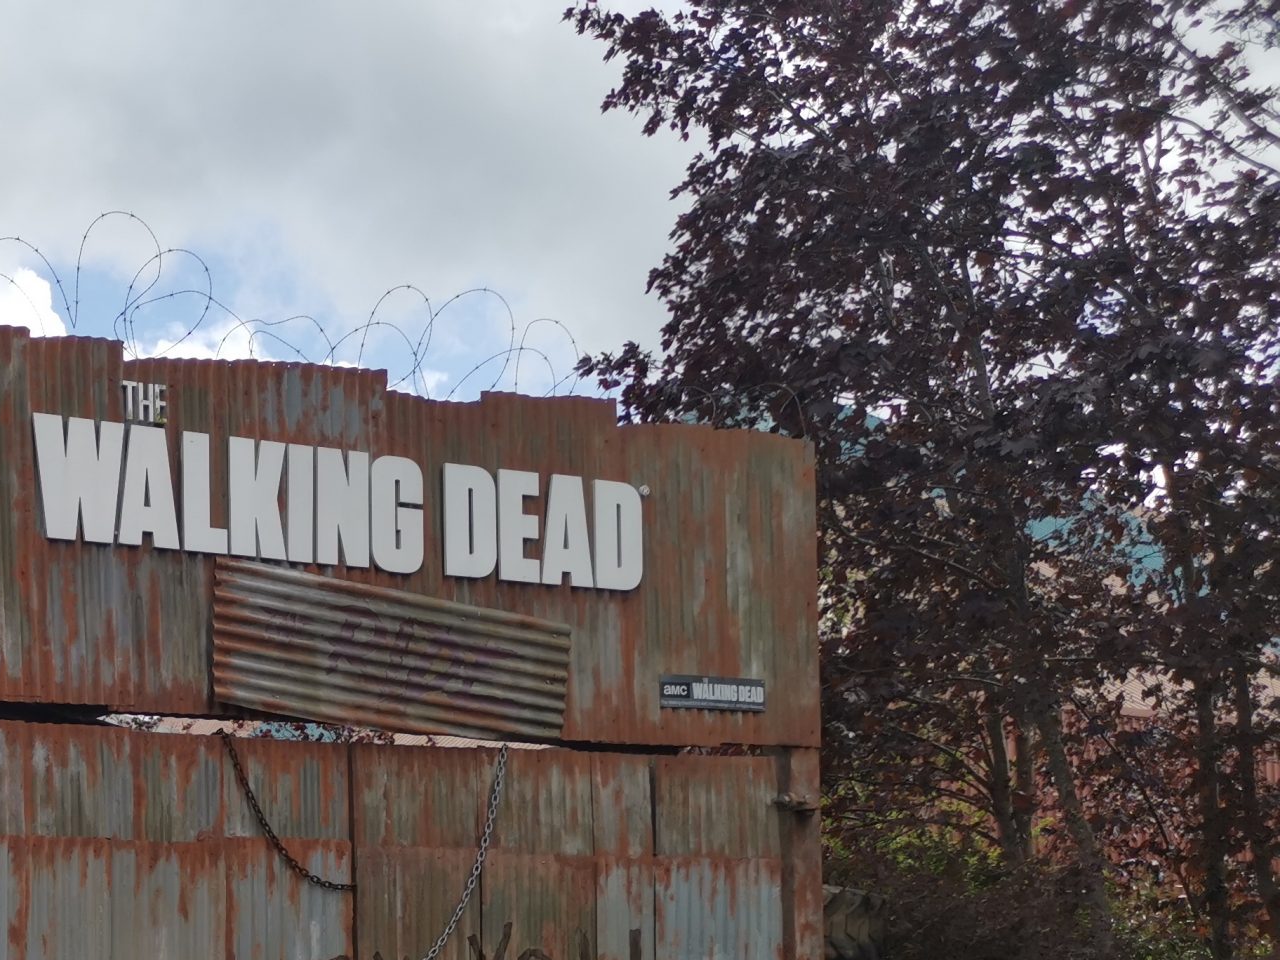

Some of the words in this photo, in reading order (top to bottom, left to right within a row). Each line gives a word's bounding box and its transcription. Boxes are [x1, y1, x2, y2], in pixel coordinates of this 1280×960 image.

[122, 380, 167, 424] THE
[32, 412, 423, 574] WALKING
[443, 463, 643, 591] DEAD
[692, 682, 737, 702] WALKING
[738, 685, 764, 703] DEAD
